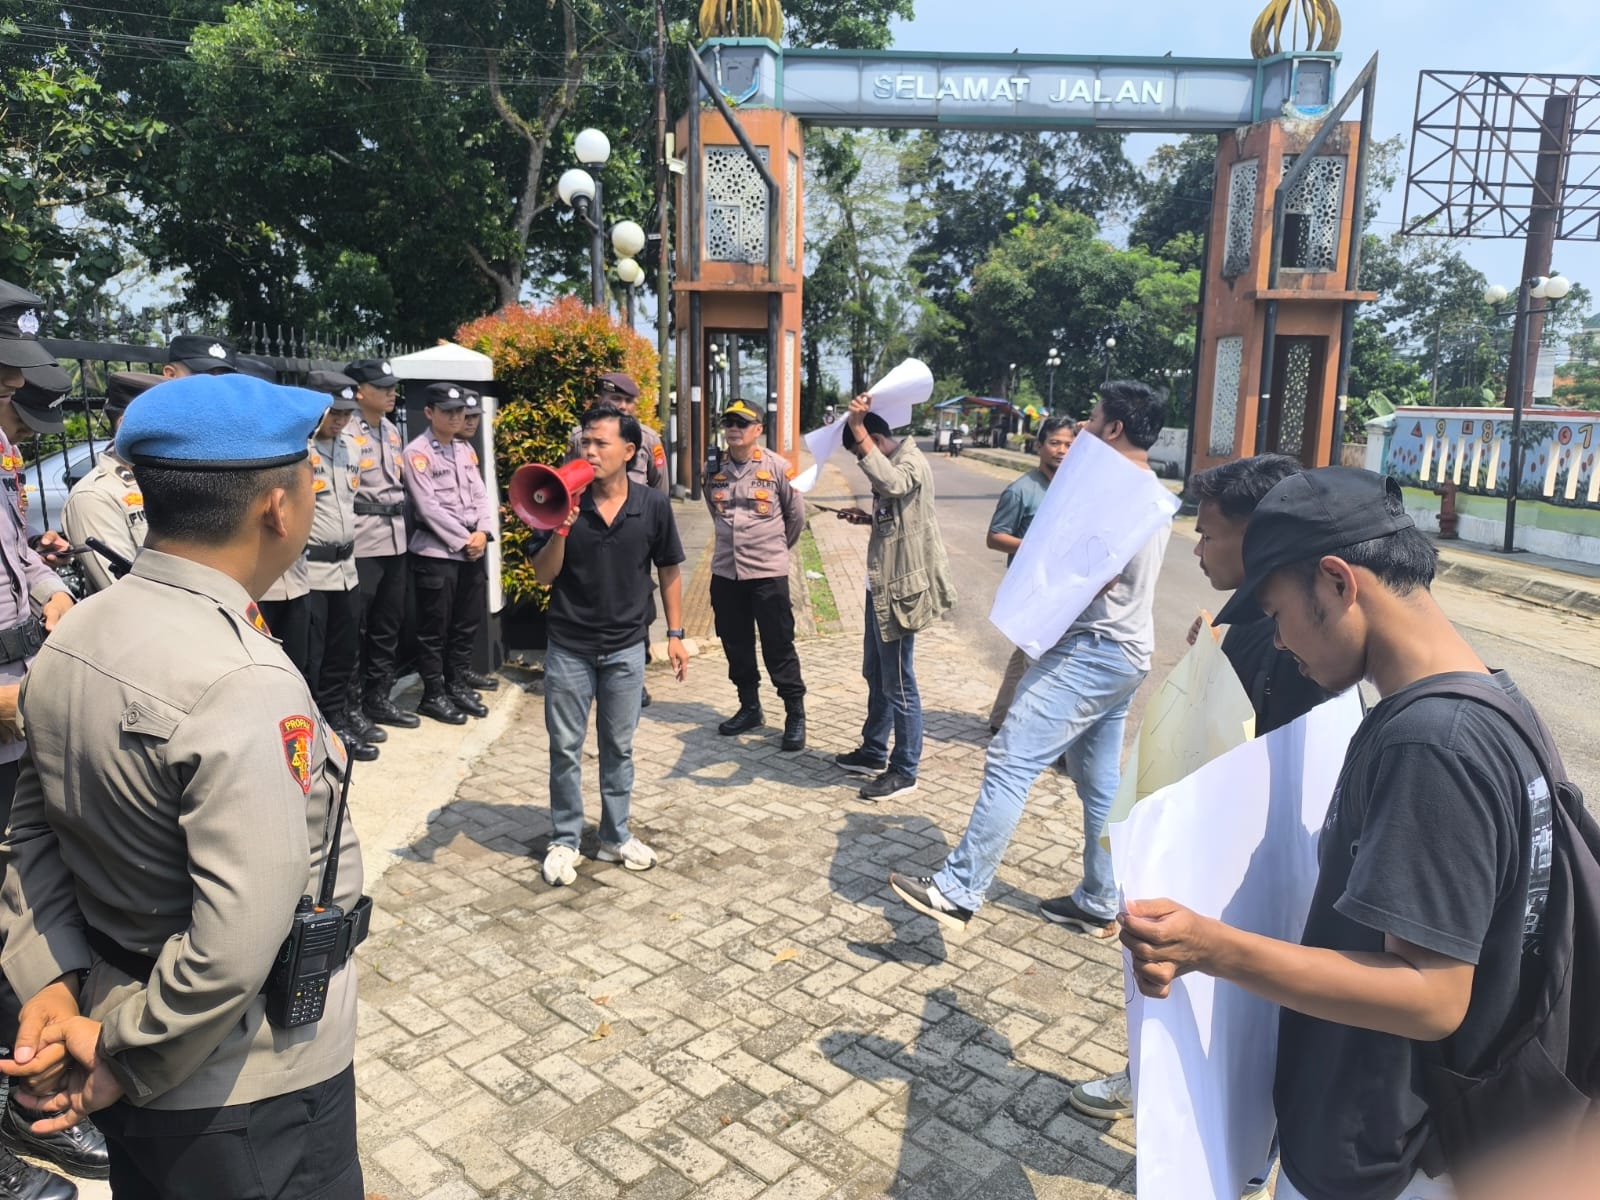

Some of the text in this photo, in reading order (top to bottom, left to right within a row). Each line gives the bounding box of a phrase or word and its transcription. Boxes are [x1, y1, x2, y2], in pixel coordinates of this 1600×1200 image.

[873, 75, 1163, 104] SELAMAT JALAN
[1436, 419, 1446, 439] 9
[1482, 420, 1494, 444] 8
[1578, 423, 1593, 449] 7
[751, 481, 774, 489] POLRI
